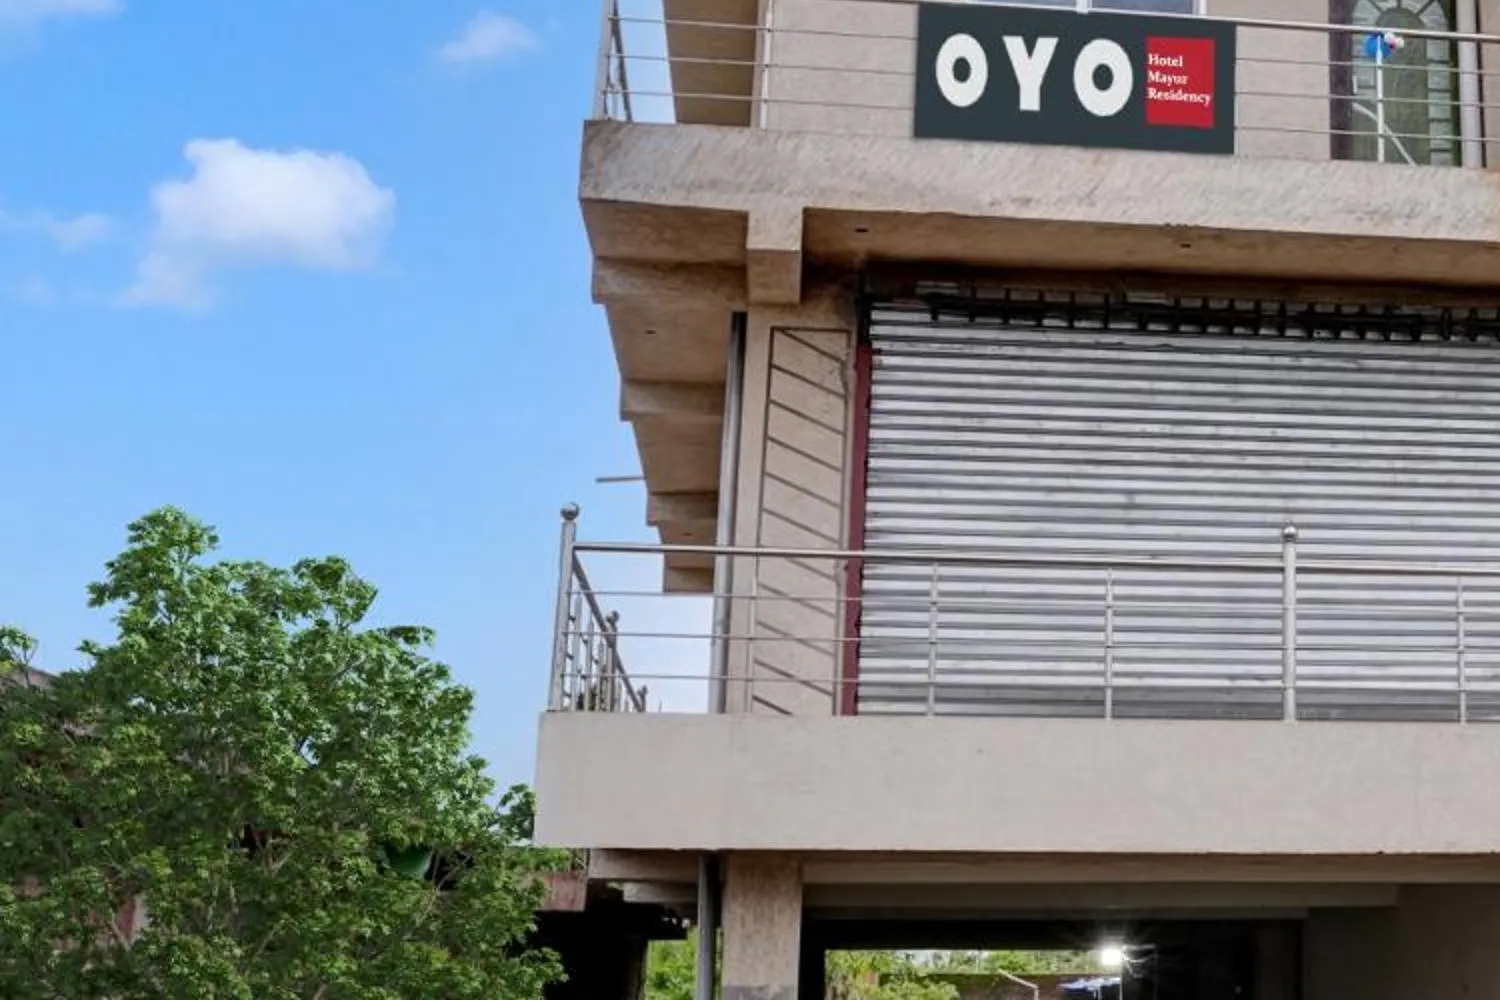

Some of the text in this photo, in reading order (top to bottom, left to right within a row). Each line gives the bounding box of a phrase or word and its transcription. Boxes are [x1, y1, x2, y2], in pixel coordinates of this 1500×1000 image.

[1148, 53, 1183, 68] Hotel
[935, 33, 1134, 117] OYO
[1148, 71, 1188, 86] Mayur
[1148, 87, 1211, 106] Residency
